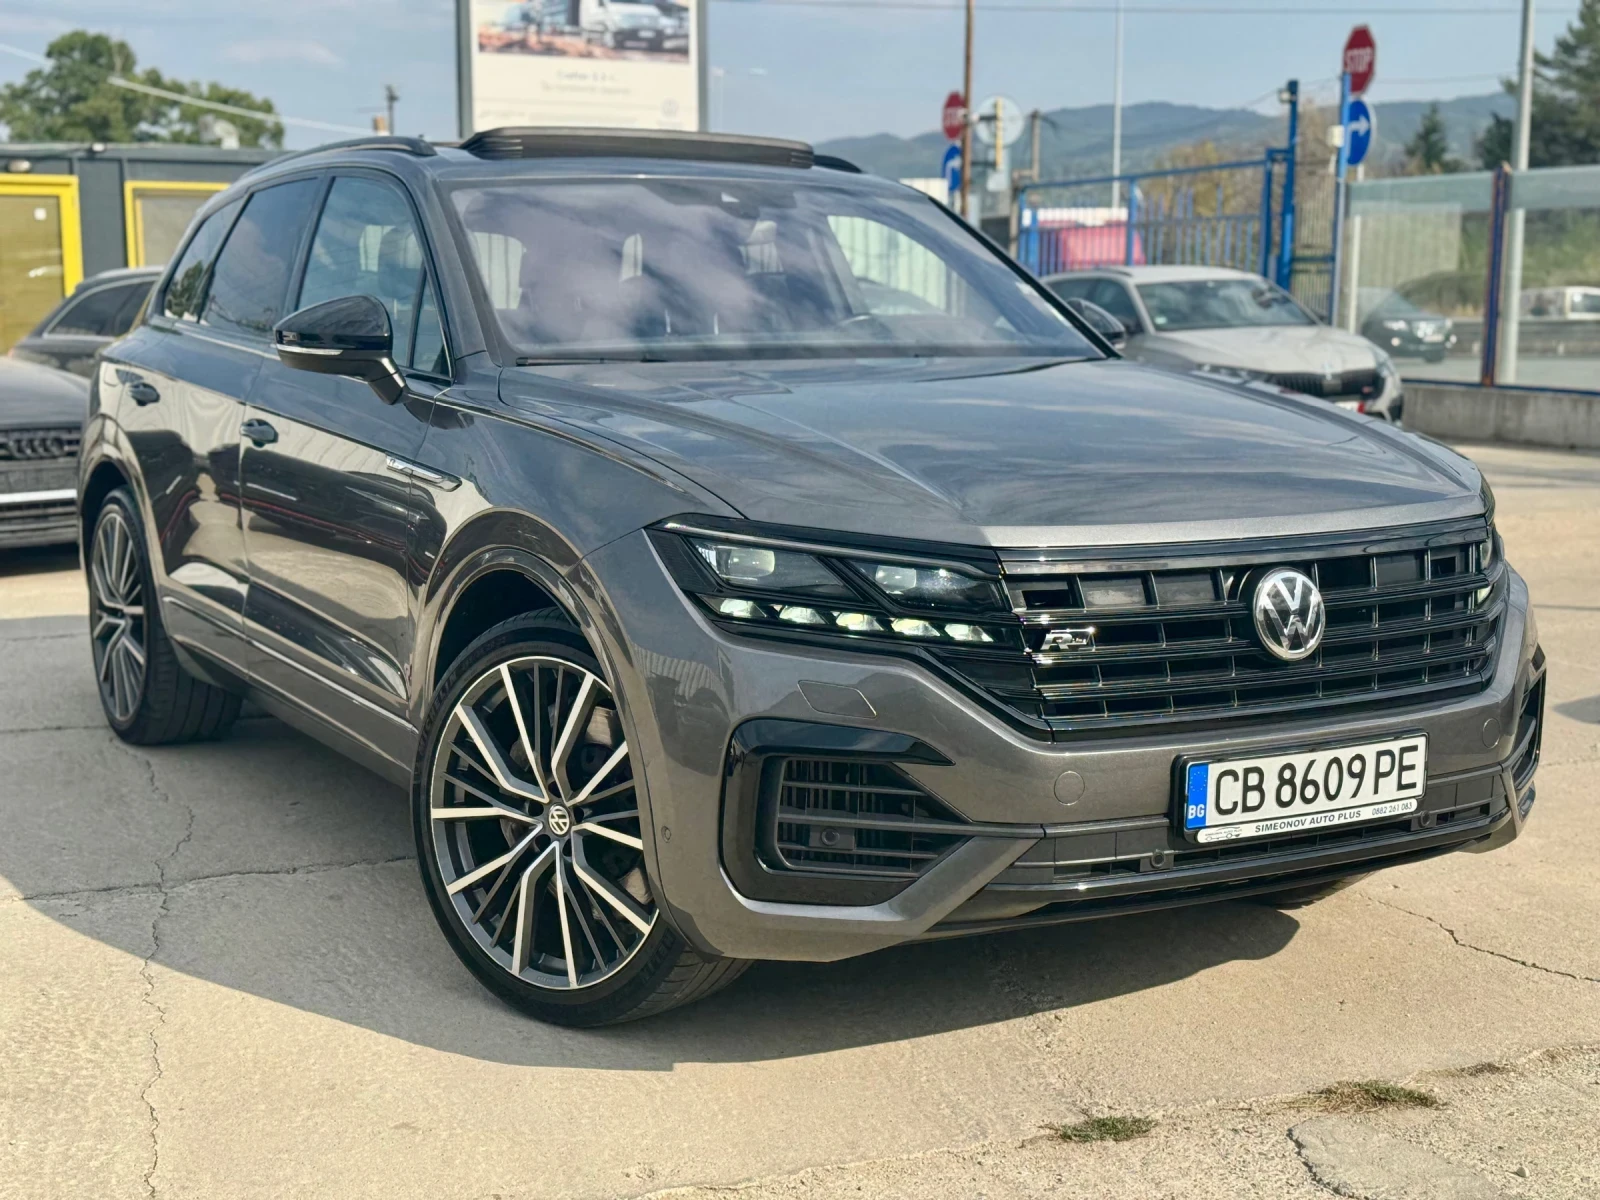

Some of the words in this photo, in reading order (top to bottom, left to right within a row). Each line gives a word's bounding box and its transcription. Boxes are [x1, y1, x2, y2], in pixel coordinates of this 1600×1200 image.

[1345, 47, 1372, 74] STOP
[1215, 765, 1266, 816] CB
[1275, 753, 1367, 809] 8609
[1373, 744, 1419, 796] PE
[1187, 803, 1206, 820] BG
[1254, 818, 1307, 834] SIMEONOV
[1309, 814, 1336, 826] AUTO
[1337, 810, 1362, 822] PLUS
[1371, 806, 1388, 816] 0882
[1388, 803, 1400, 813] 261
[1400, 801, 1413, 811] 083
